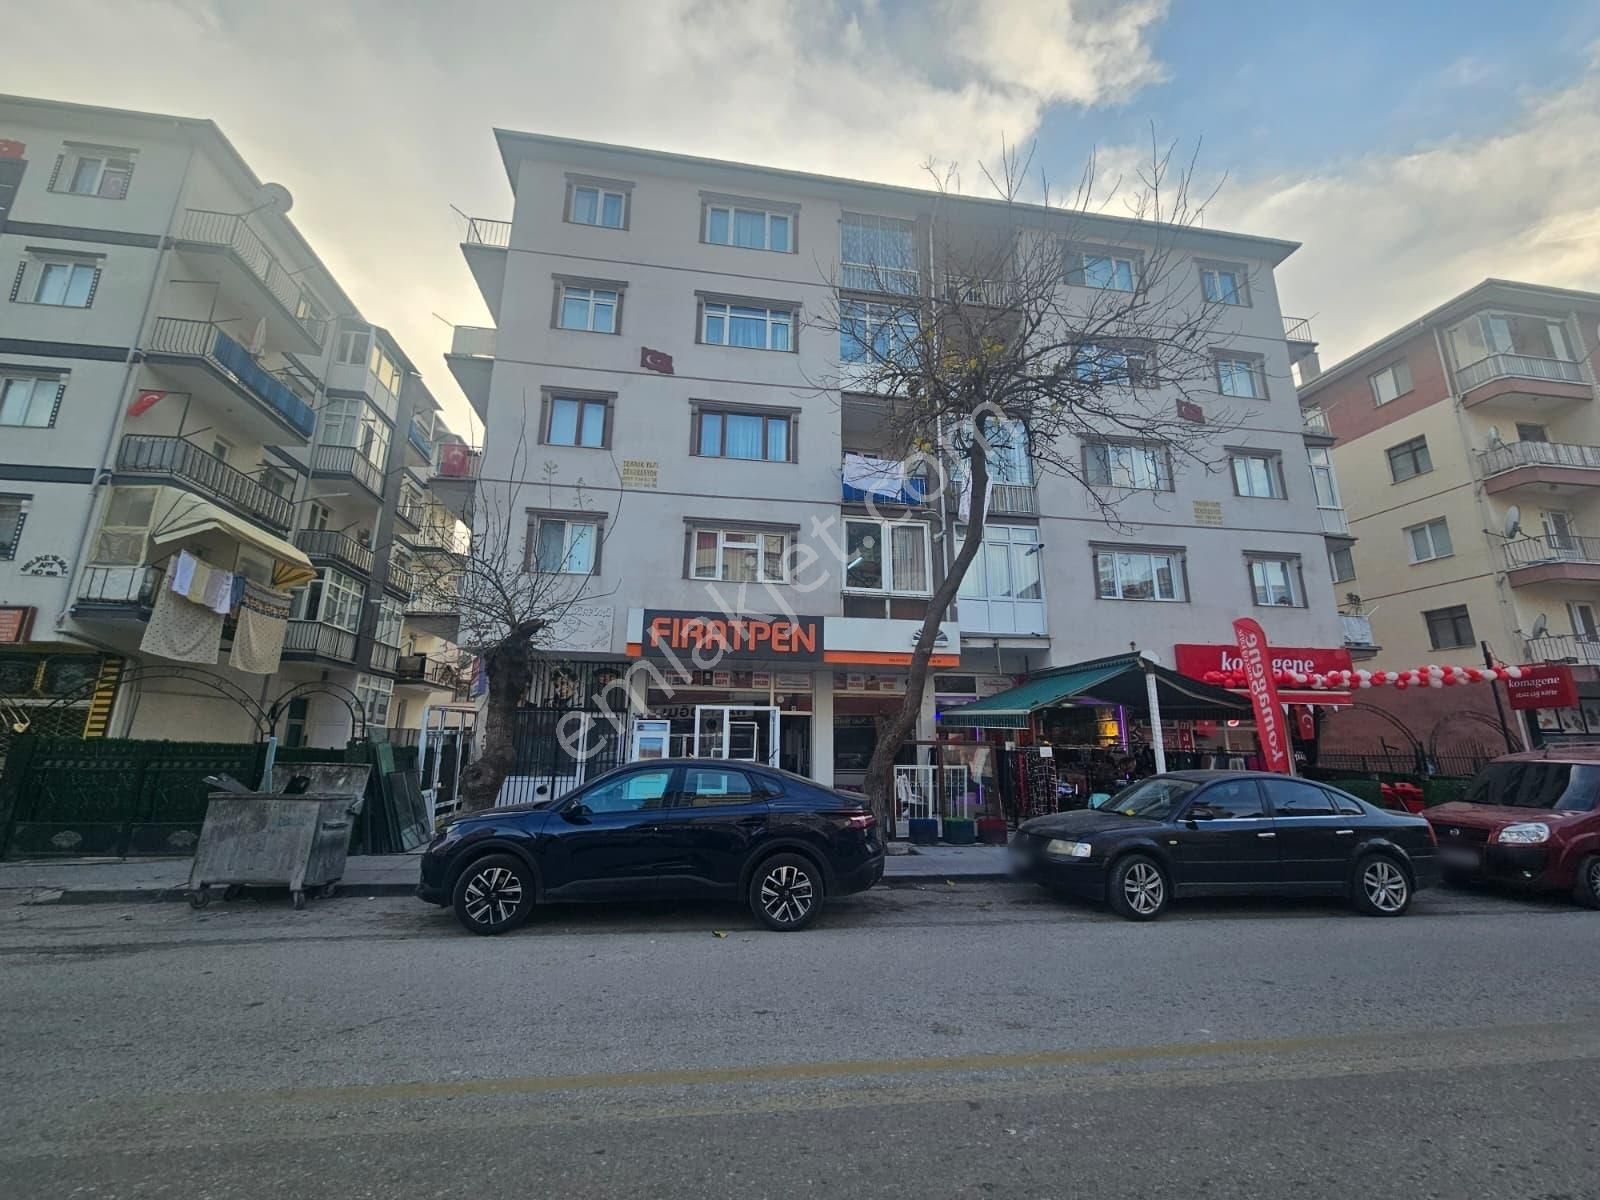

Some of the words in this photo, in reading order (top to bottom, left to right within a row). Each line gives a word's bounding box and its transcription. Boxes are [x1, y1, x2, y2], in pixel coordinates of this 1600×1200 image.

[651, 617, 816, 653] FIRATPEN
[1221, 651, 1314, 676] kogene
[1508, 676, 1560, 689] komagene
